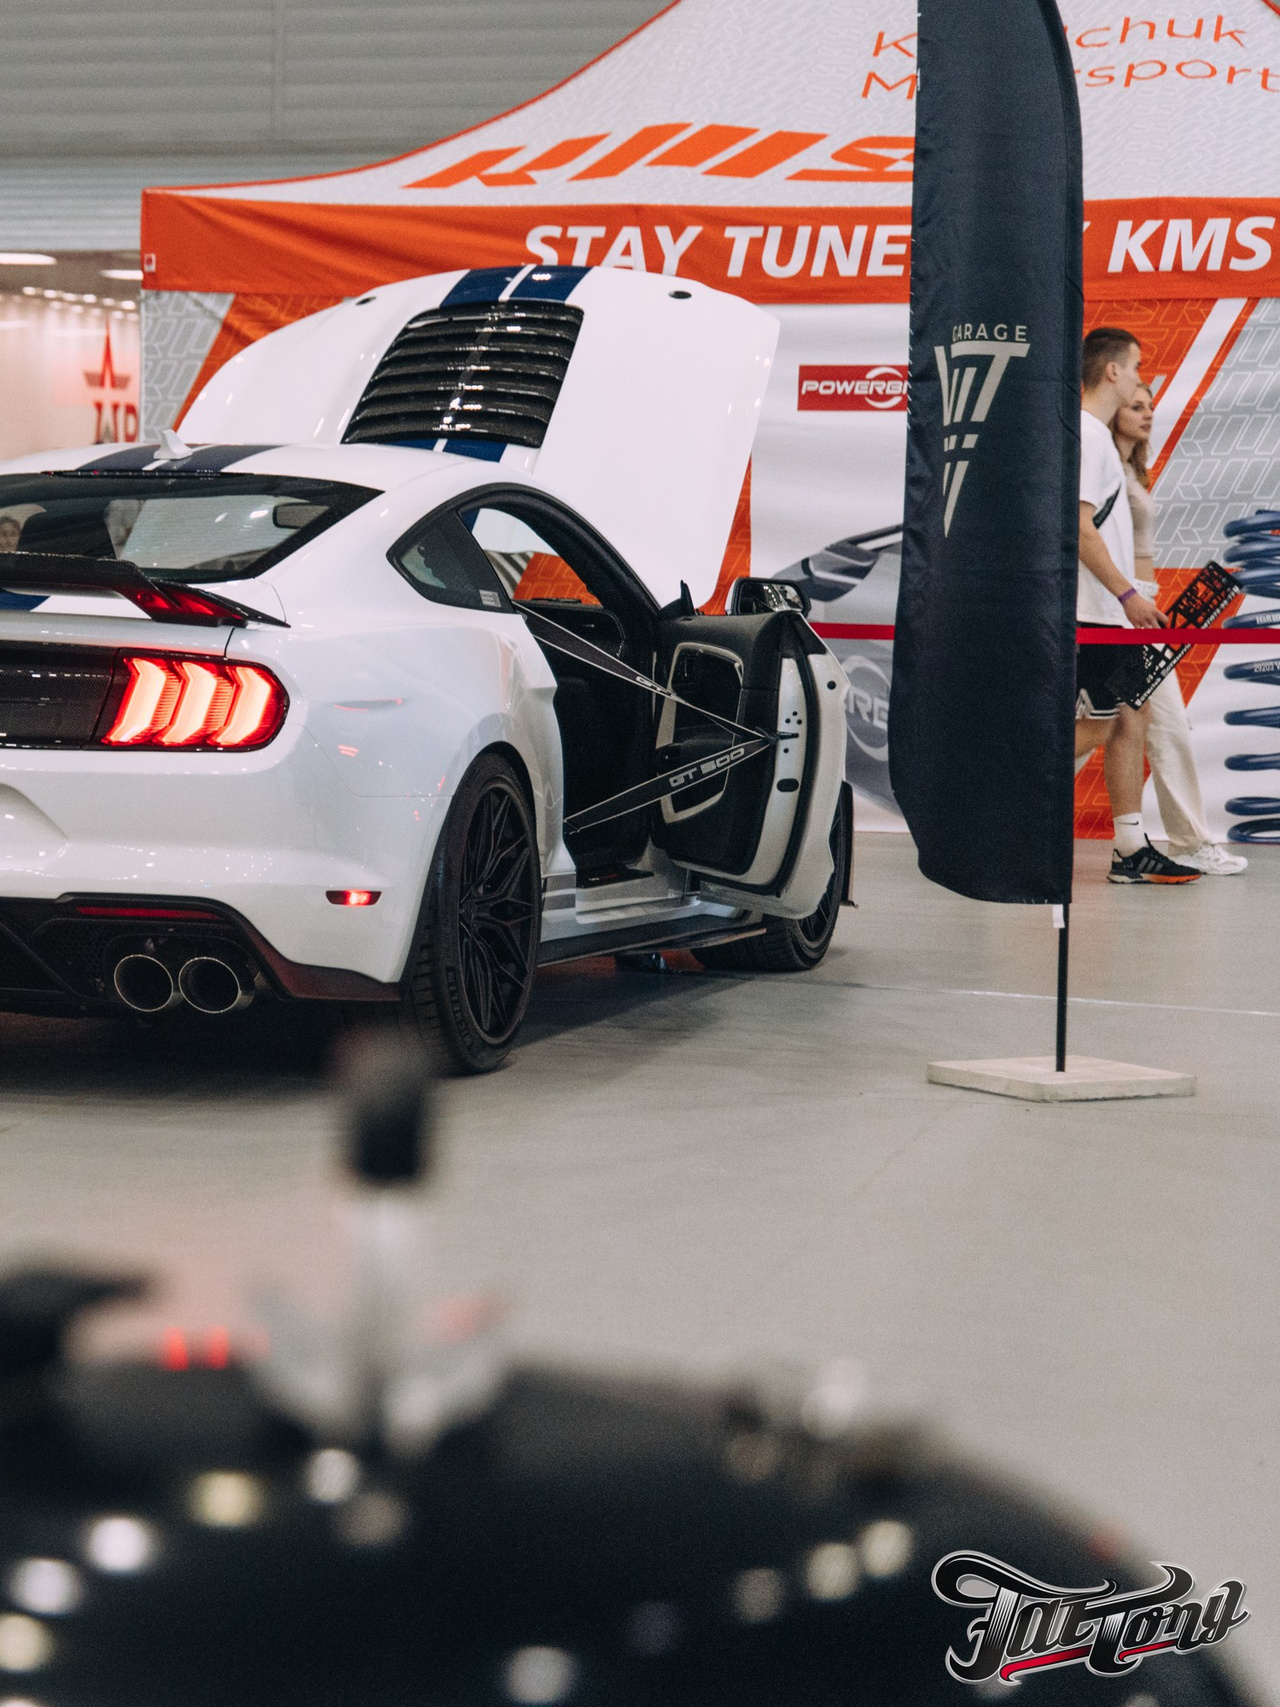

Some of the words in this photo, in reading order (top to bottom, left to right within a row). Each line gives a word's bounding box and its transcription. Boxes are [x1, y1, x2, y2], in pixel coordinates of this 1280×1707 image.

[525, 224, 704, 275] STAY
[1107, 215, 1276, 273] KMS
[952, 322, 1028, 342] GARAGE
[669, 767, 697, 788] GT
[700, 747, 745, 775] 500
